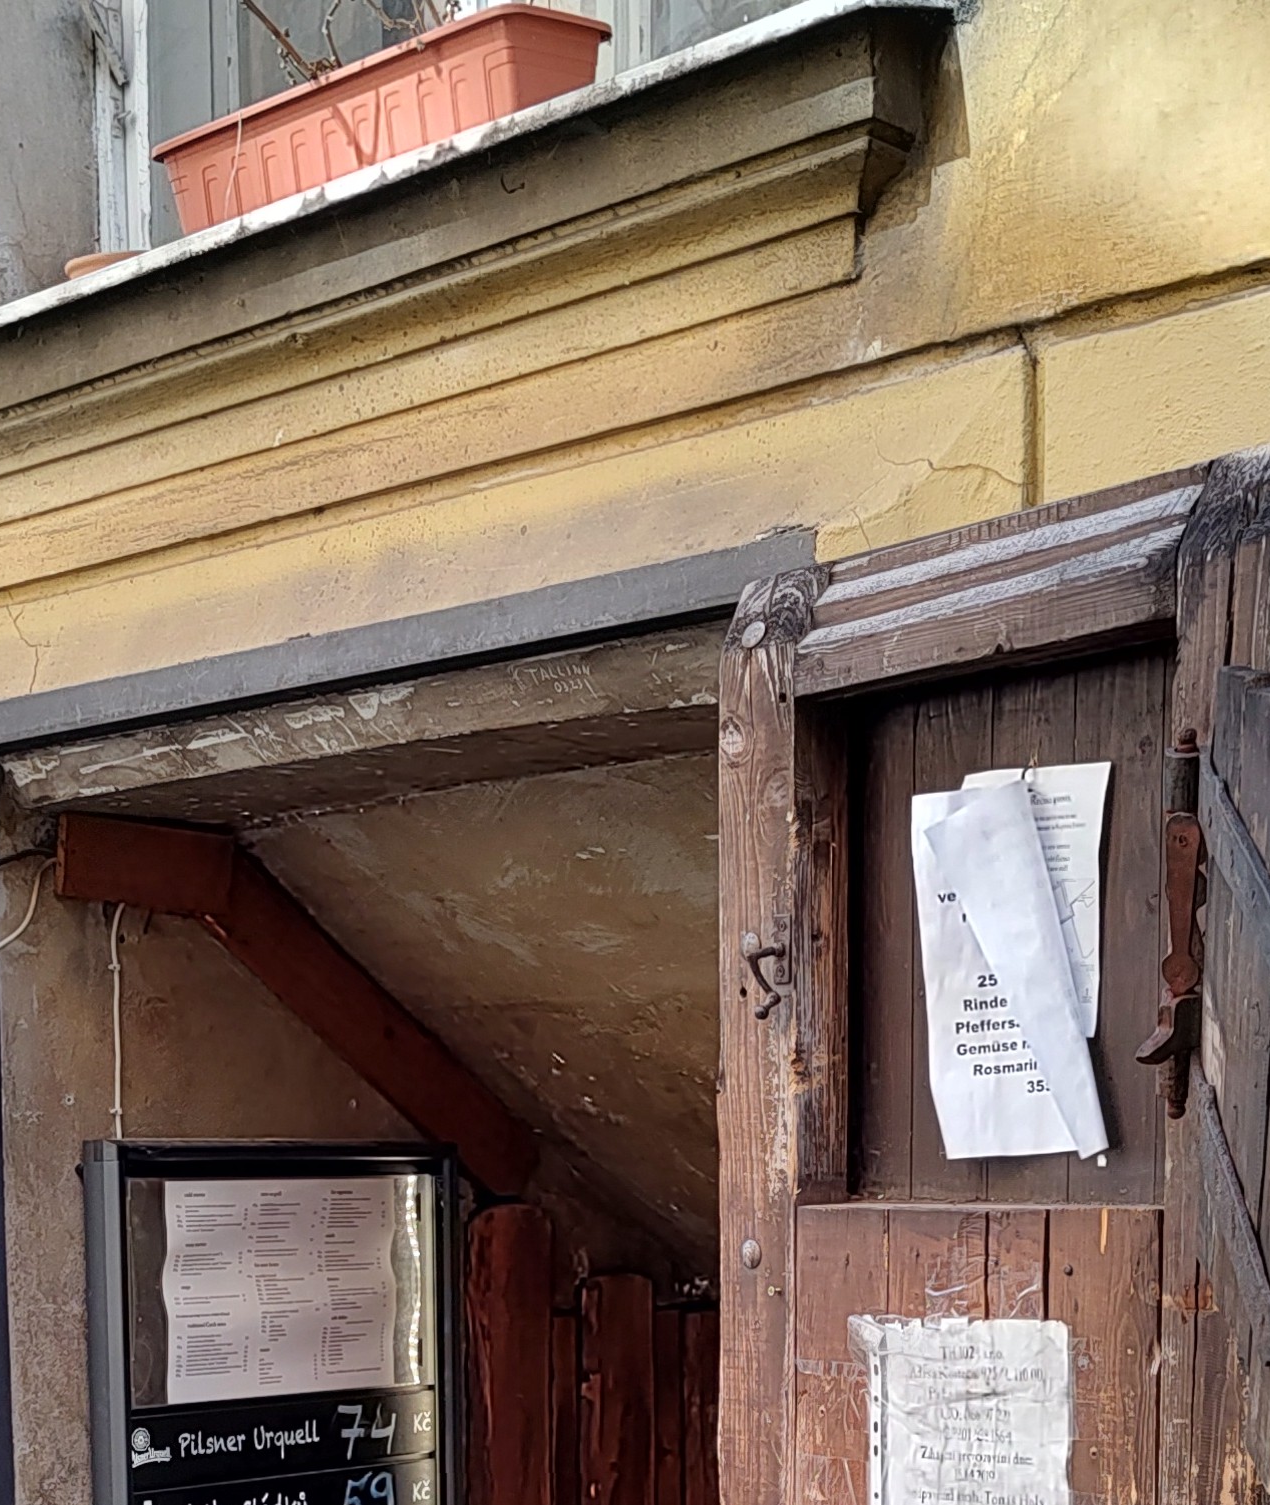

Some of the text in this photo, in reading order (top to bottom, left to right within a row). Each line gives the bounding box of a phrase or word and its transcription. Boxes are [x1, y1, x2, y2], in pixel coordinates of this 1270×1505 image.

[977, 974, 998, 988] 25
[956, 1040, 1018, 1056] Gemüse
[178, 1403, 432, 1460] Pilsner Urquell 74 Kč
[412, 1480, 431, 1502] Kč
